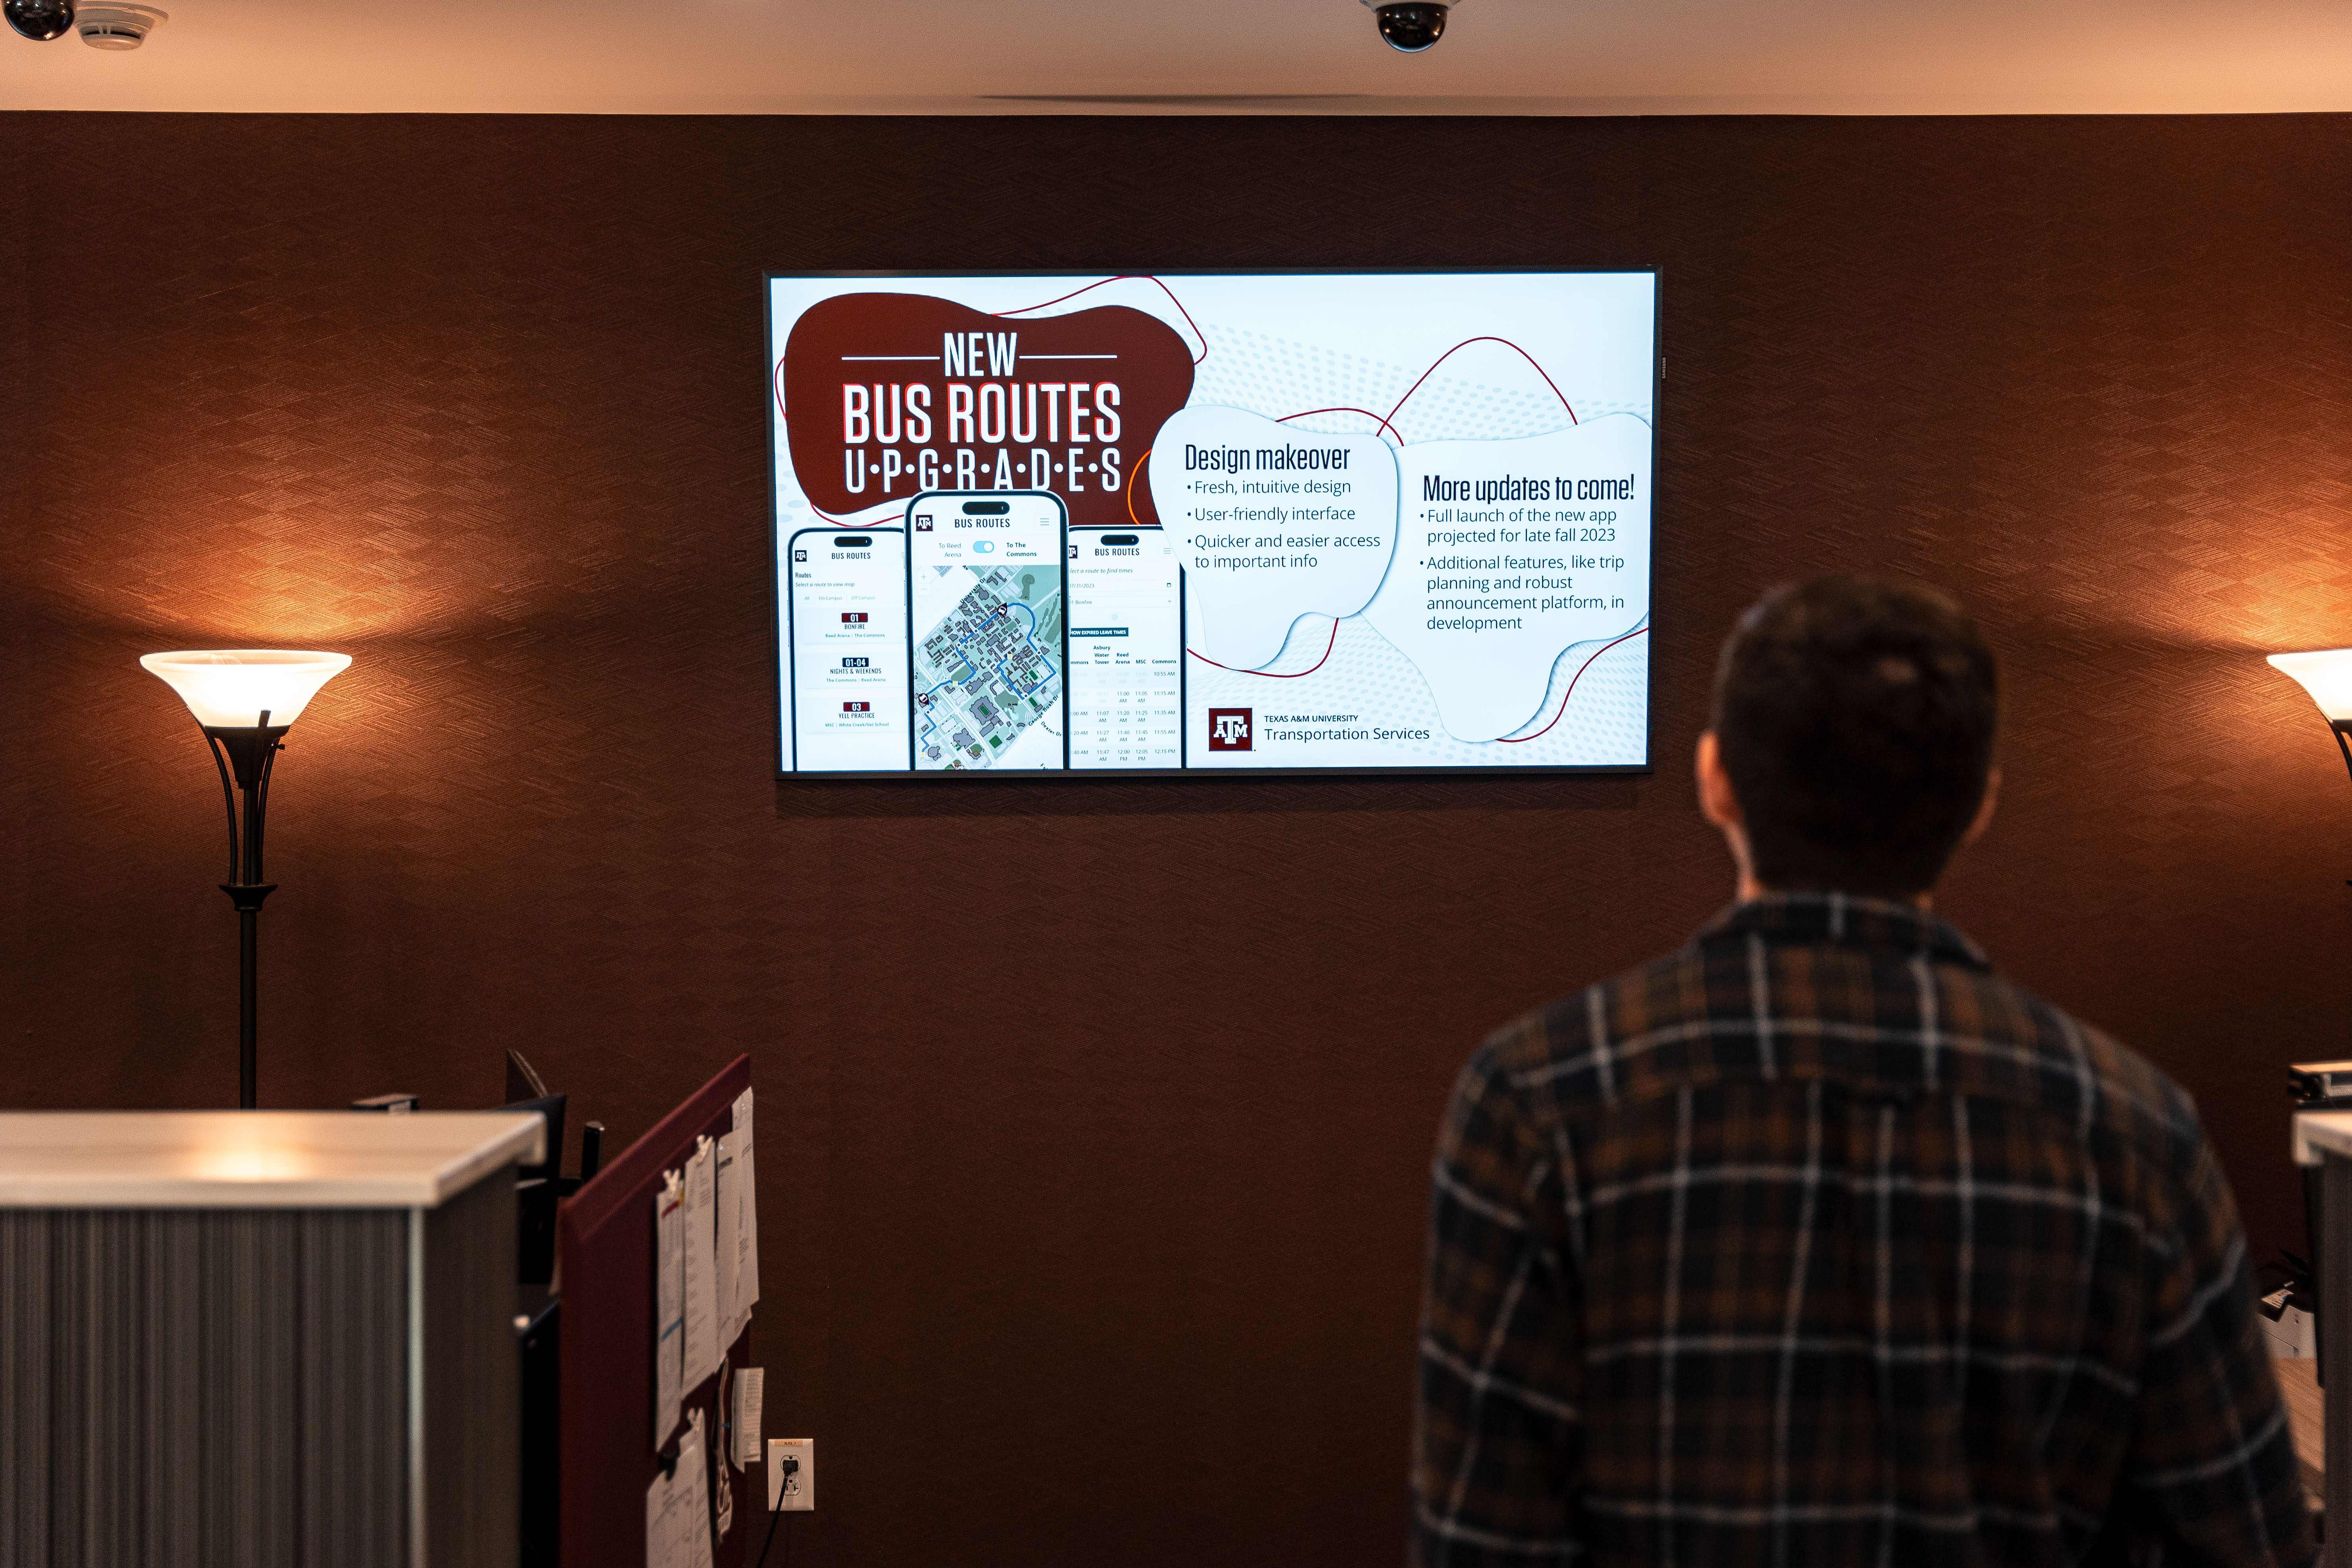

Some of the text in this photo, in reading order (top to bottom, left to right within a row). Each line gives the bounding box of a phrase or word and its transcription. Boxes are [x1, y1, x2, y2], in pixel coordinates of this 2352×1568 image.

[945, 333, 1017, 376] NEW
[843, 381, 1120, 443] BUS ROUTES
[1186, 443, 1350, 474] Design makeover
[1196, 480, 1350, 497] Fresh, intuitive design
[1424, 474, 1634, 505] More updates to come!
[955, 519, 1010, 528] BUS ROUTES
[1196, 507, 1355, 524] User-friendly interface
[1429, 508, 1616, 525] Full launch of the new app
[1196, 534, 1380, 550] Quicker and easier access
[1428, 528, 1615, 546] projected for late fall 2023
[1195, 554, 1317, 571] to important info
[1427, 555, 1624, 572] Additional features, like trip
[1428, 576, 1572, 593] planning and robust
[960, 584, 980, 603] University
[1427, 595, 1623, 613] announcement platform, in
[1428, 616, 1522, 633] development
[1028, 712, 1044, 726] George
[1043, 701, 1054, 712] Bush
[1264, 728, 1429, 743] Transportation Services
